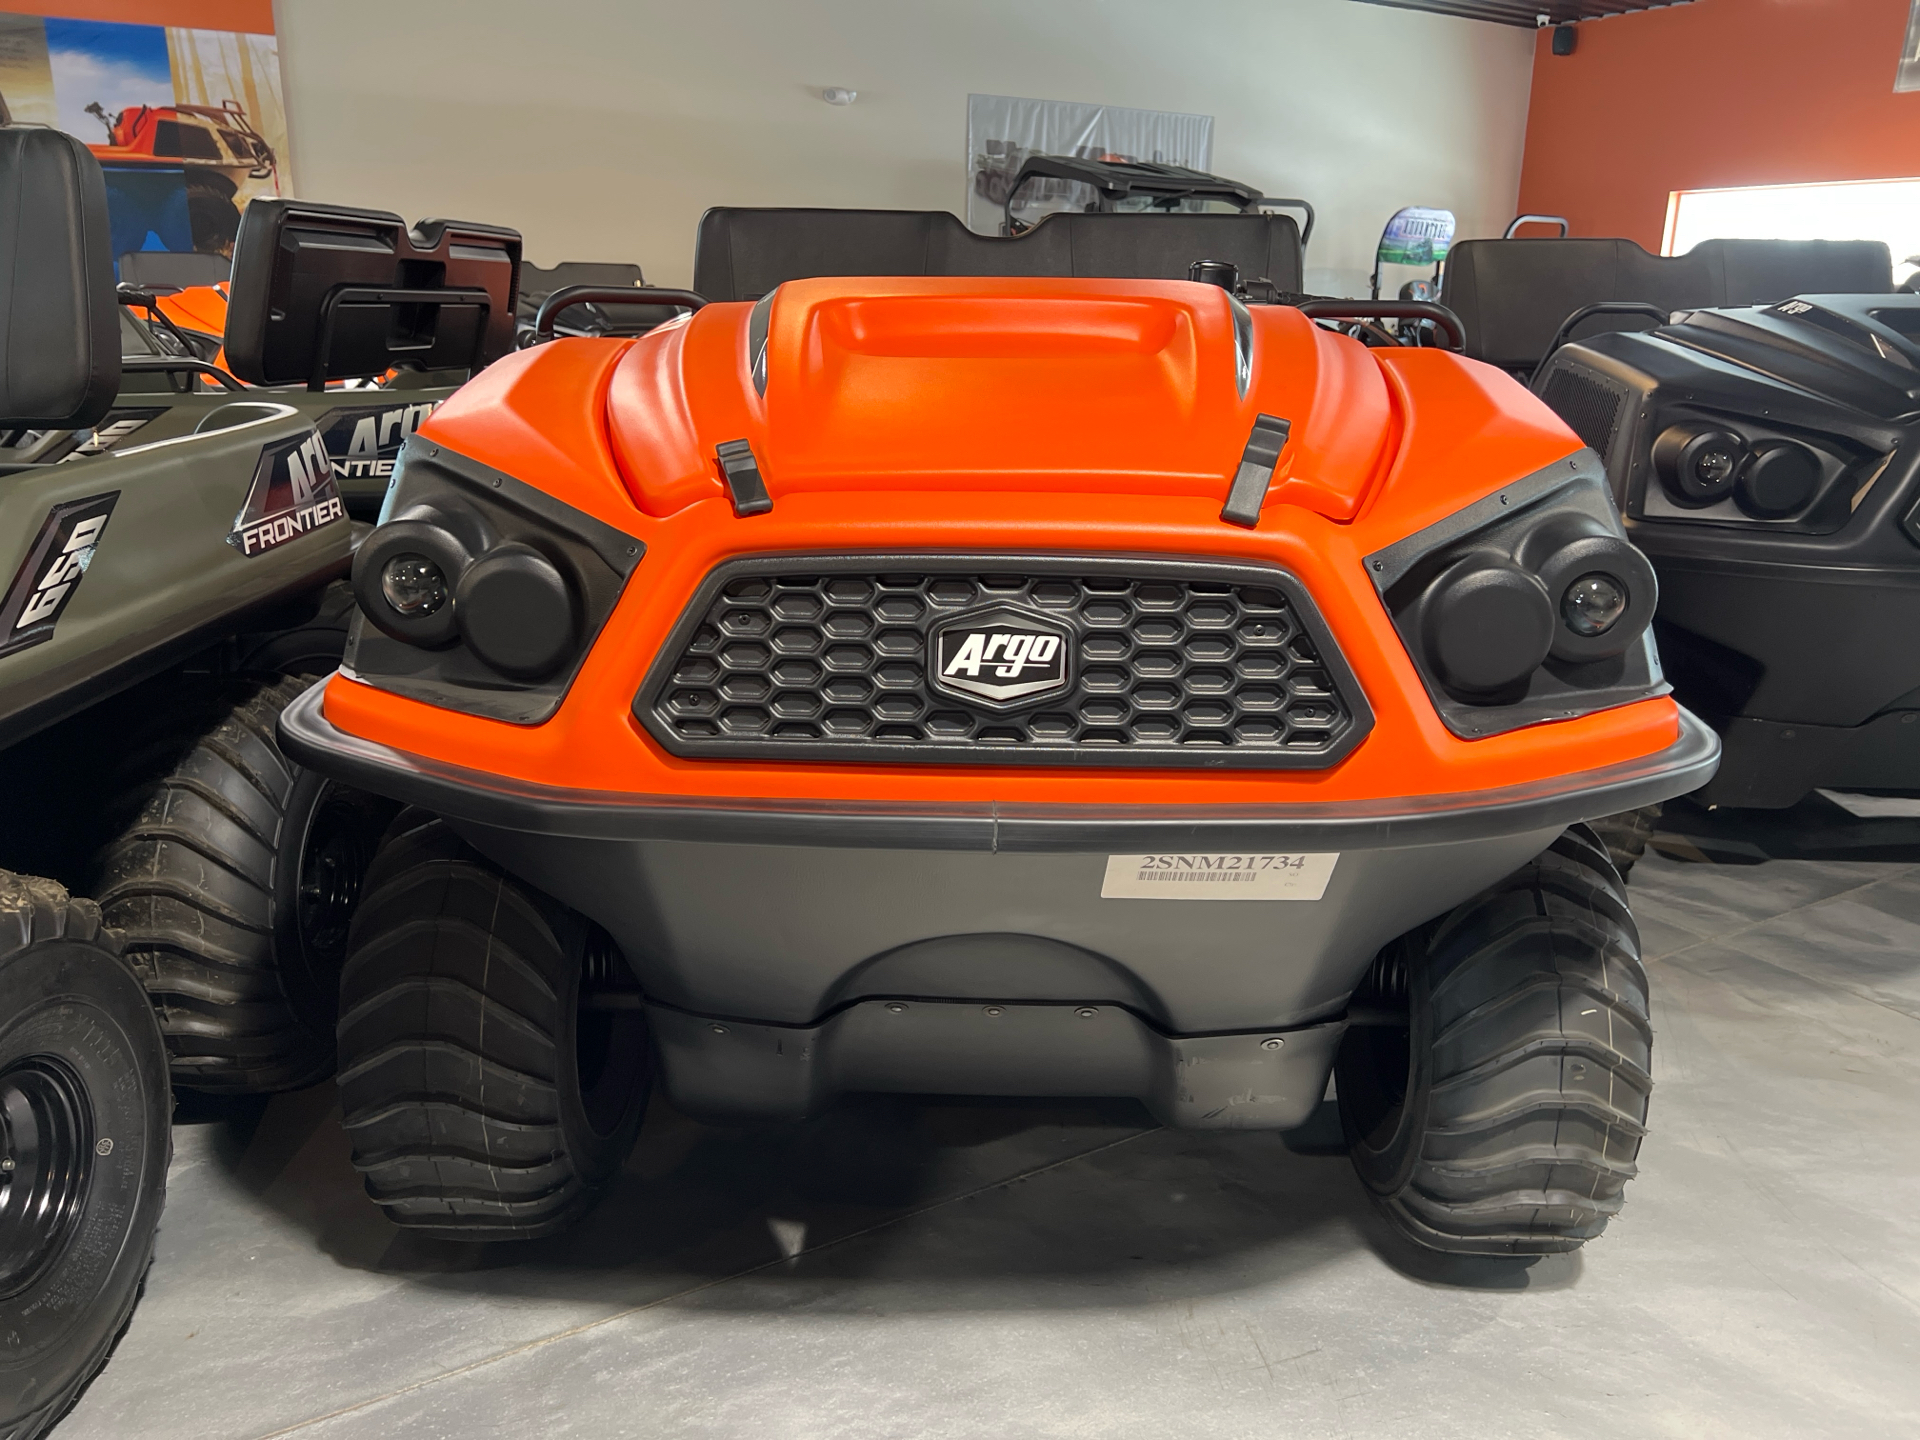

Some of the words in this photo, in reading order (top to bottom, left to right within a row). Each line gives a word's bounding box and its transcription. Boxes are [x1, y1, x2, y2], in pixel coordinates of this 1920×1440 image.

[347, 402, 443, 459] Arg
[243, 497, 342, 554] FRONTIER
[16, 514, 107, 629] 650
[943, 633, 1060, 678] Argo
[1140, 855, 1306, 870] 2SNM21734
